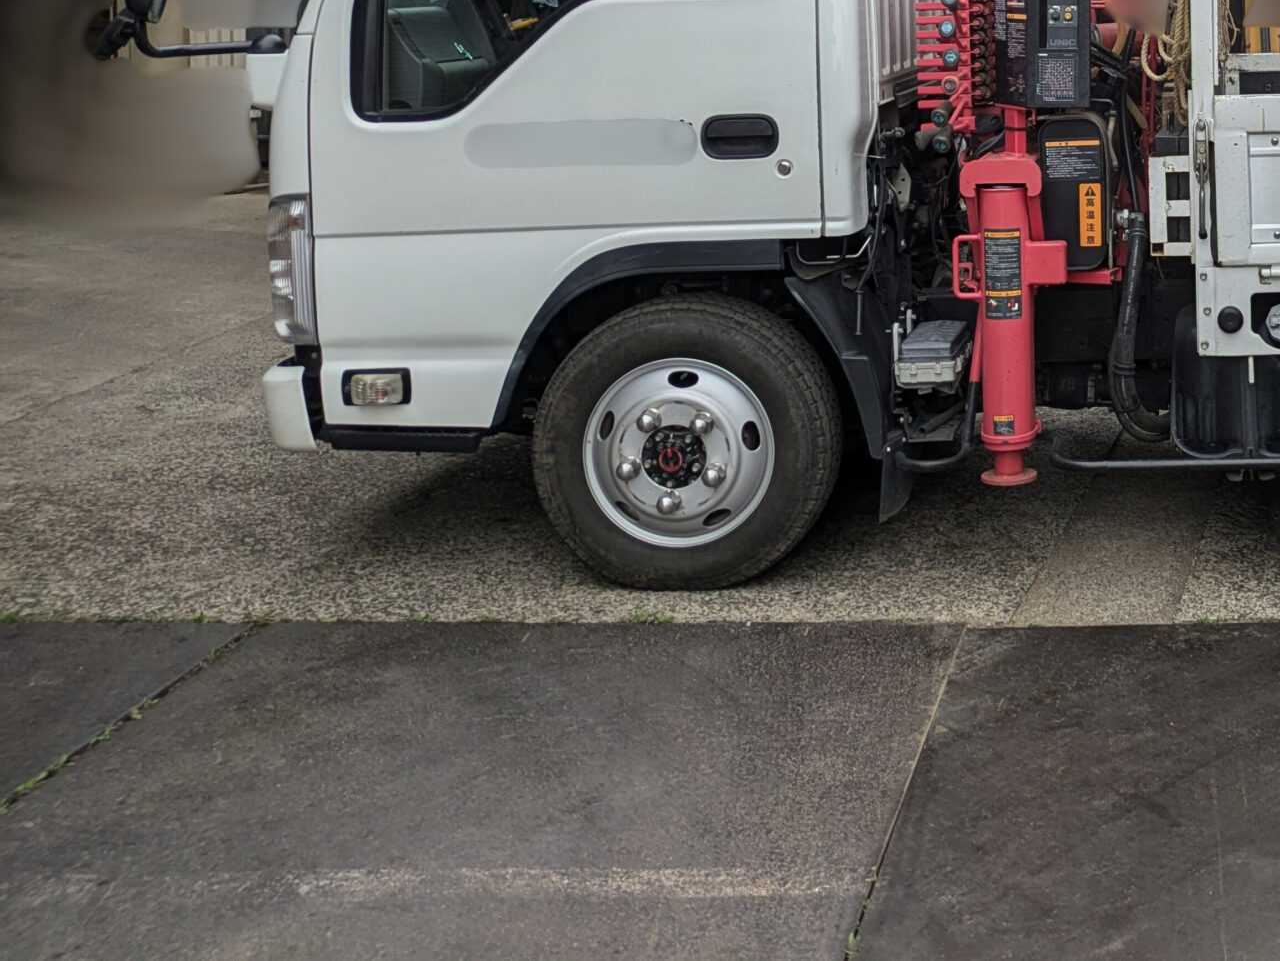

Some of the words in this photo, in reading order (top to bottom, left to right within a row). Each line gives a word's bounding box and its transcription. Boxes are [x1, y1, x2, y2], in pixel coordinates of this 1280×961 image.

[1049, 38, 1077, 47] UNIC
[1085, 198, 1096, 244] 高温注意
